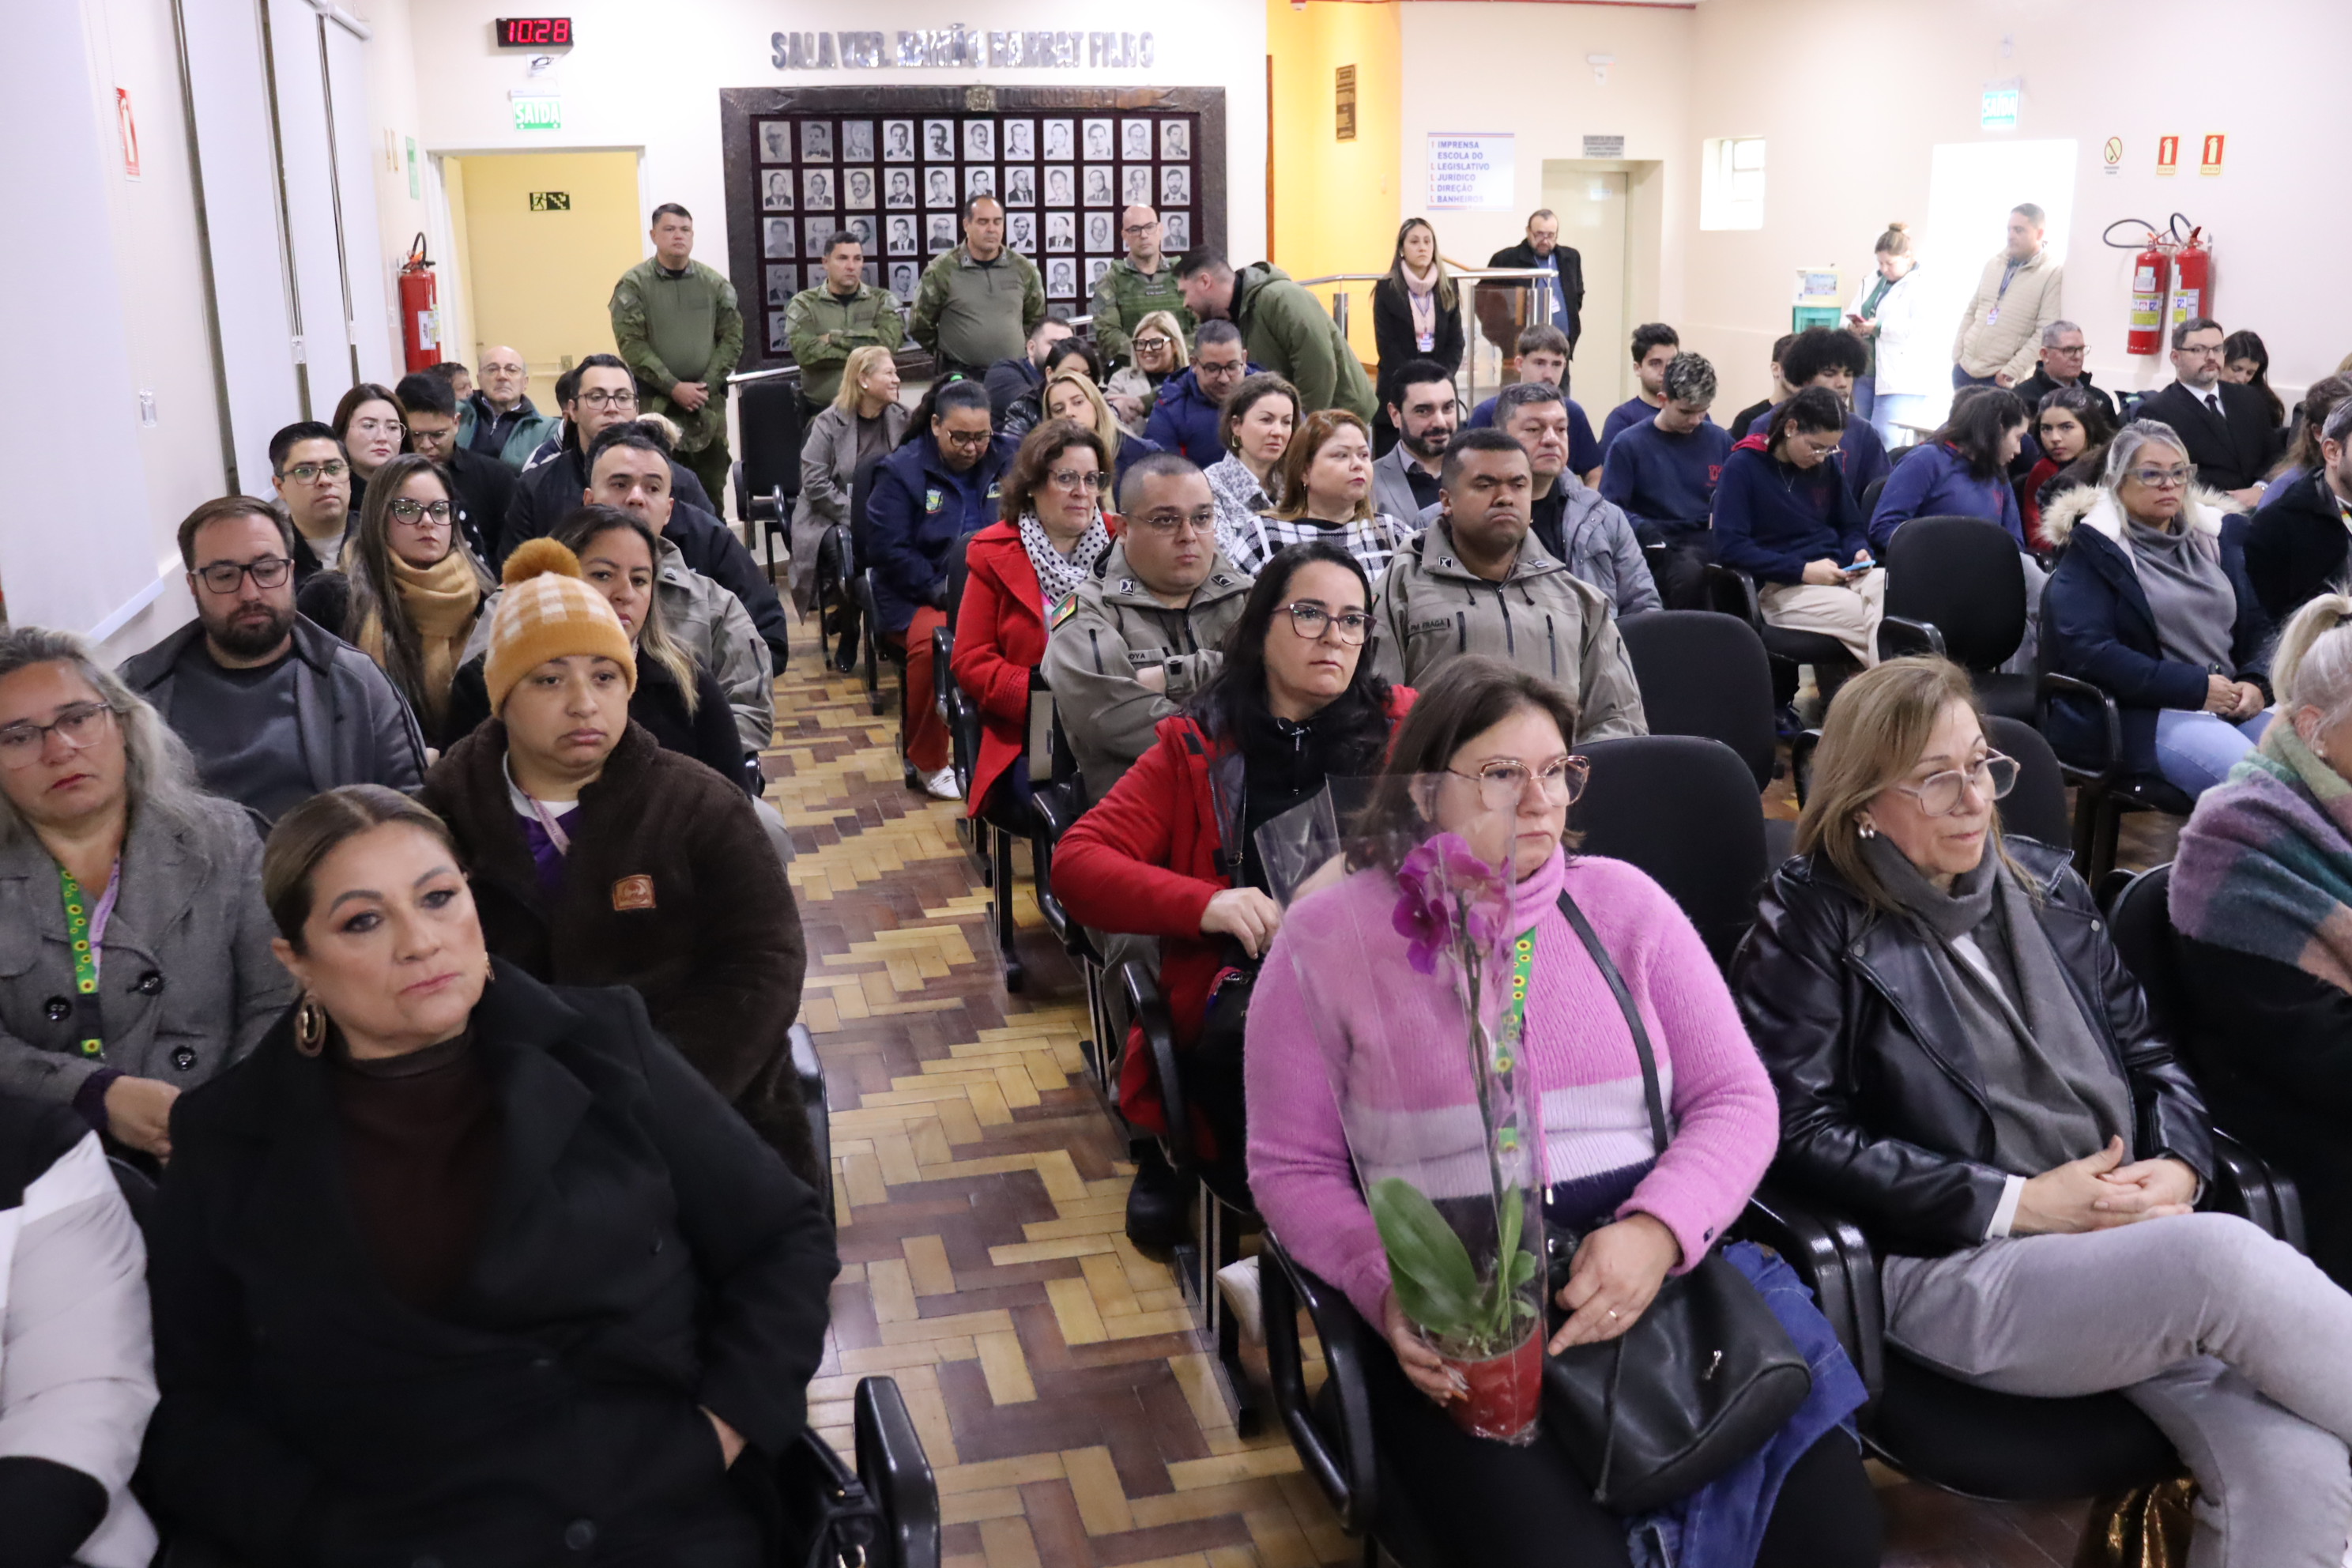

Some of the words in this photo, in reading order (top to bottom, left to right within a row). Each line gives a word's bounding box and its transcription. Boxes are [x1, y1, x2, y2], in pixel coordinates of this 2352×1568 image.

[771, 32, 838, 69] SALA
[1089, 31, 1155, 68] FILHO
[1982, 94, 2016, 118] SAÍDA
[514, 100, 560, 124] SAÍDA
[1438, 141, 1479, 149] IMPRENSA
[1437, 172, 1476, 182] JURÍDICO
[1437, 183, 1473, 193] DIREÇÃO
[1422, 619, 1445, 630] FRAGA
